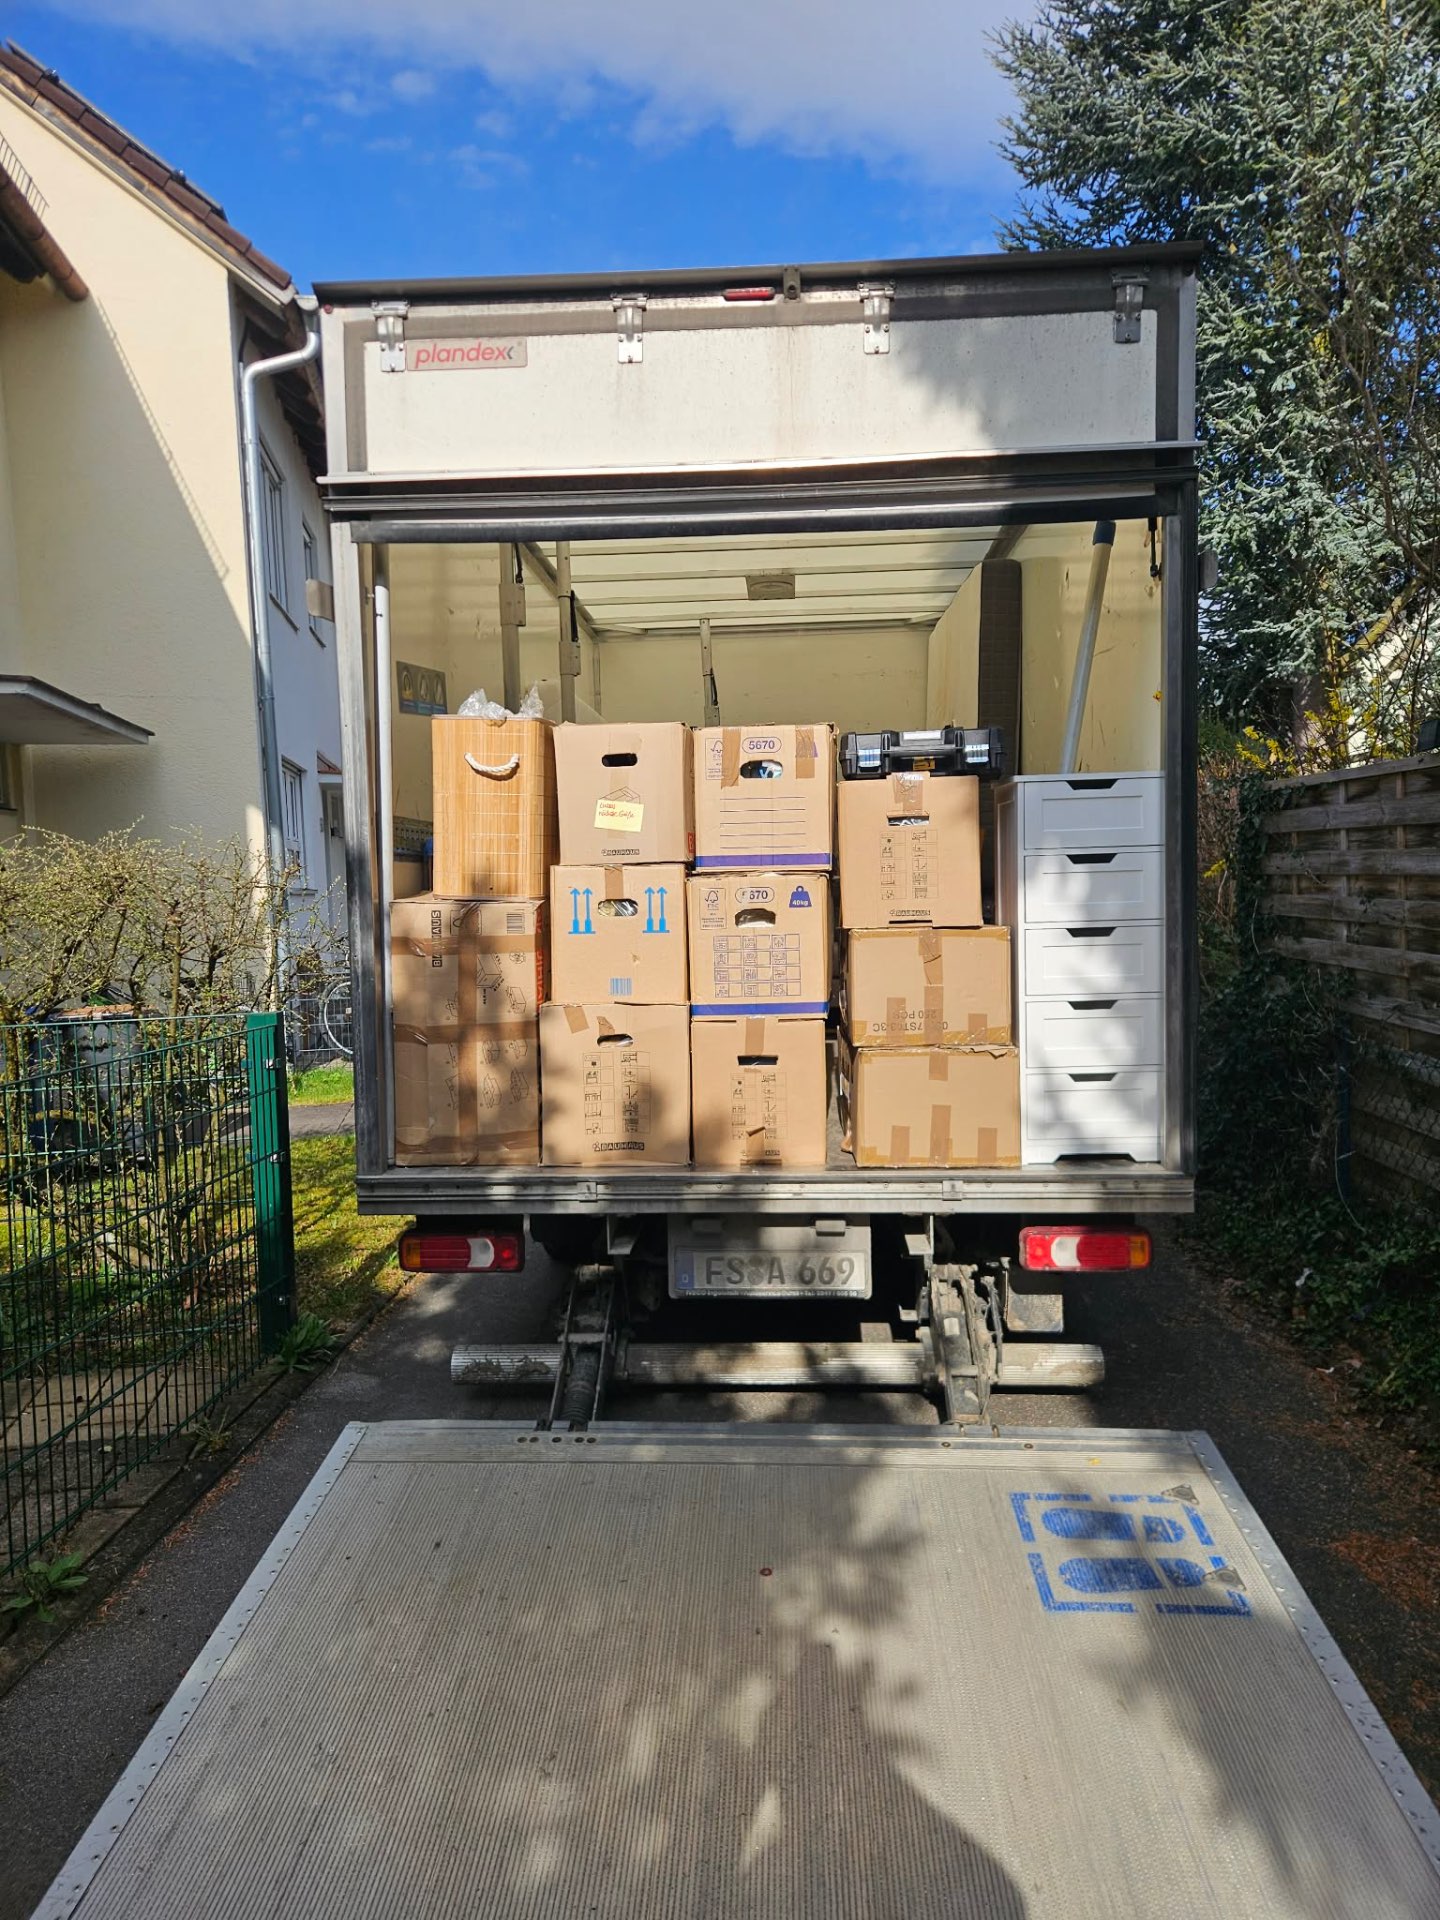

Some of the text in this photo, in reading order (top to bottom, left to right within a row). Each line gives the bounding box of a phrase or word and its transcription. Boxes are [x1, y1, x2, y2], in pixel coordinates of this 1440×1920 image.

[414, 341, 508, 369] plandex
[748, 740, 775, 750] 5670
[792, 899, 809, 907] 40kg
[600, 1141, 645, 1152] BAUHAUS
[705, 1256, 745, 1285] FS
[767, 1256, 786, 1285] A
[798, 1256, 856, 1286] 669
